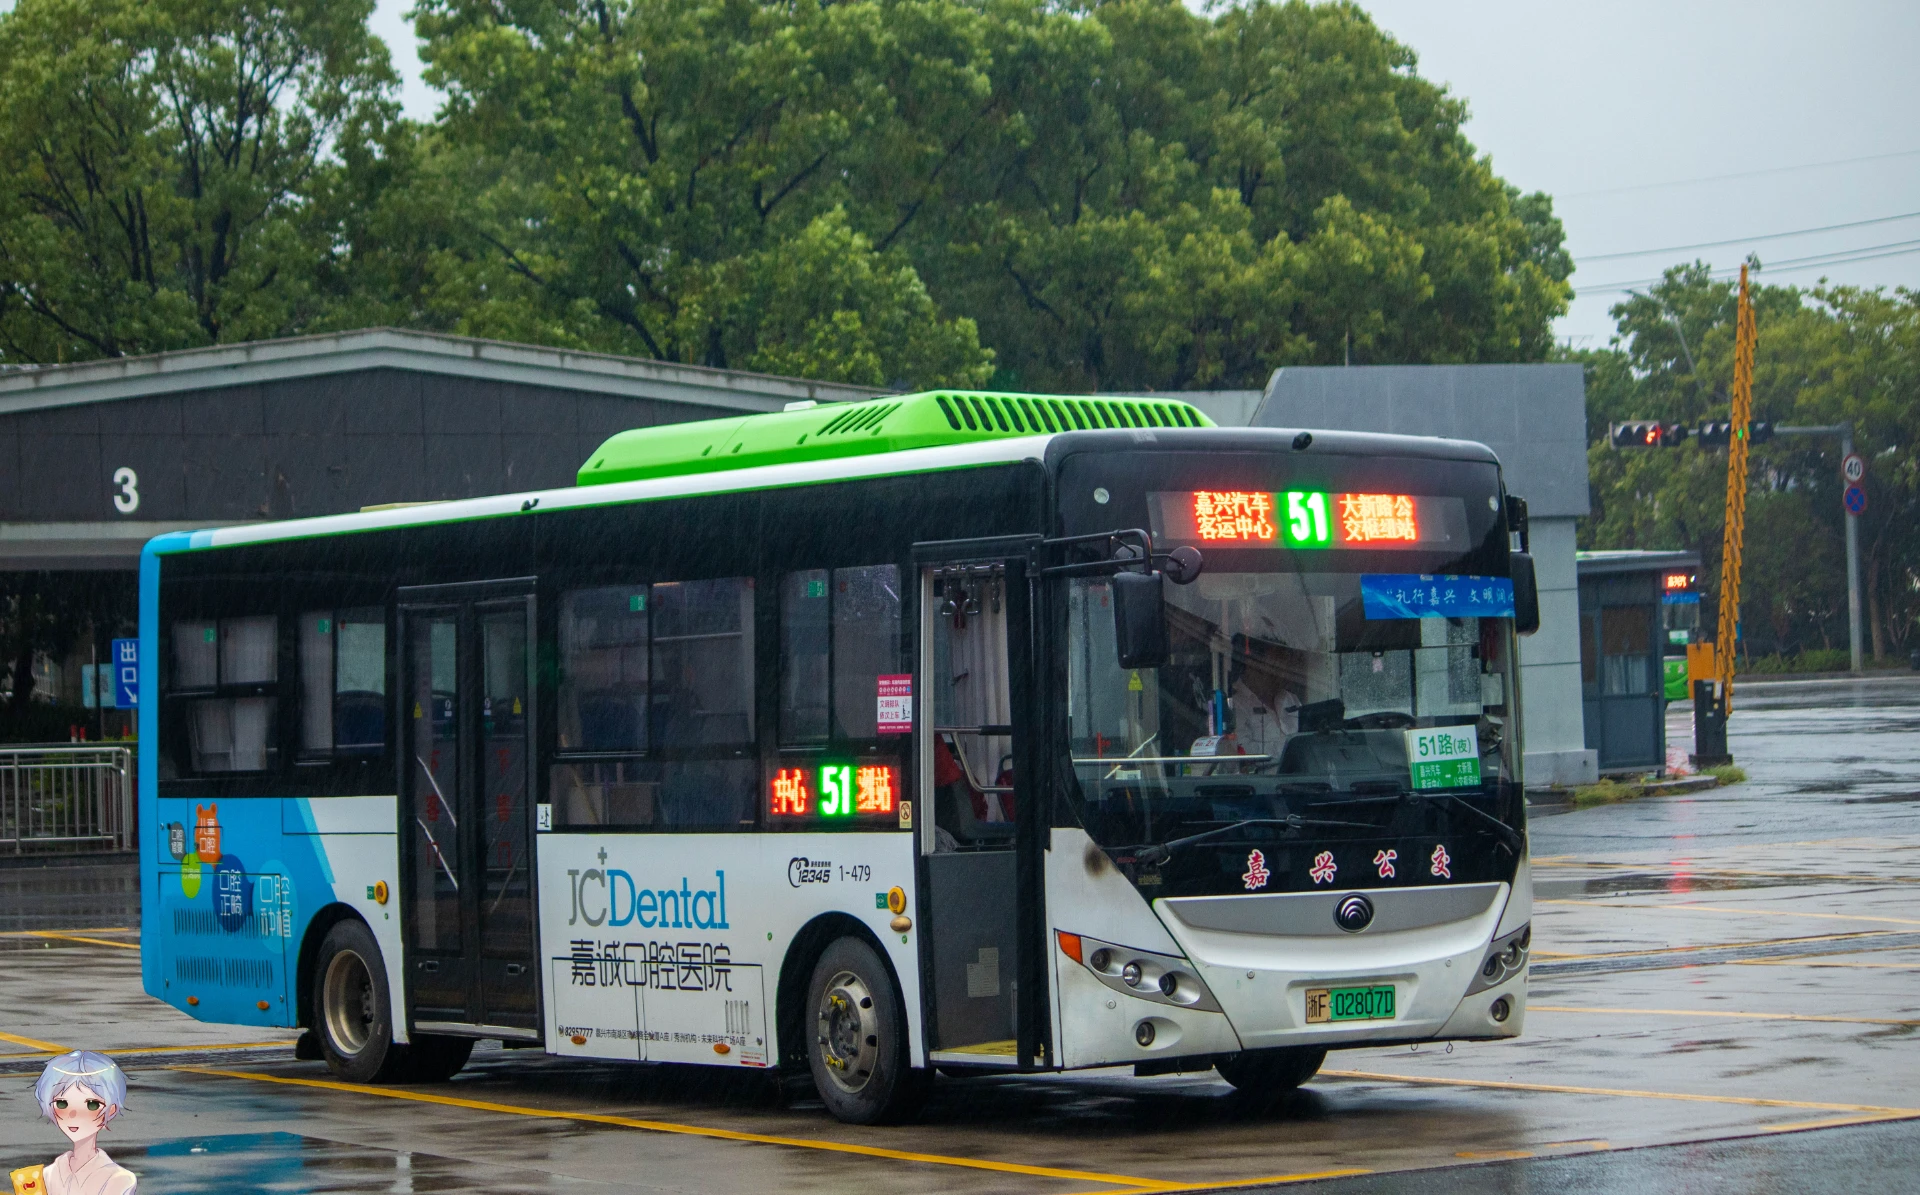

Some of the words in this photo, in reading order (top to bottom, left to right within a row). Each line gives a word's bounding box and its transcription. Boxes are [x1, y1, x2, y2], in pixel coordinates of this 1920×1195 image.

[1847, 461, 1860, 476] 40
[113, 466, 138, 513] 3
[1194, 490, 1271, 517] 嘉兴汽车
[1287, 491, 1328, 541] 51
[1339, 493, 1413, 518] 大新路公
[1198, 515, 1273, 539] 客运中心
[1343, 518, 1416, 541] 交枢纽站
[121, 641, 137, 683] 出口
[1420, 764, 1441, 777] 嘉兴汽车
[1457, 762, 1472, 774] 大新路
[821, 766, 850, 814] 51
[200, 818, 216, 835] 儿童
[200, 837, 216, 854] 口腔
[798, 869, 831, 883] 12345
[839, 865, 871, 881] 1-479
[1242, 844, 1451, 889] 嘉兴公交
[220, 869, 242, 892] 口腔
[260, 875, 290, 905] 口腔
[220, 894, 242, 916] 正畸
[260, 907, 292, 937] 种植
[570, 939, 733, 992] 嘉诚口腔医院
[1308, 994, 1327, 1018] 浙F
[1335, 990, 1393, 1016] 02807D
